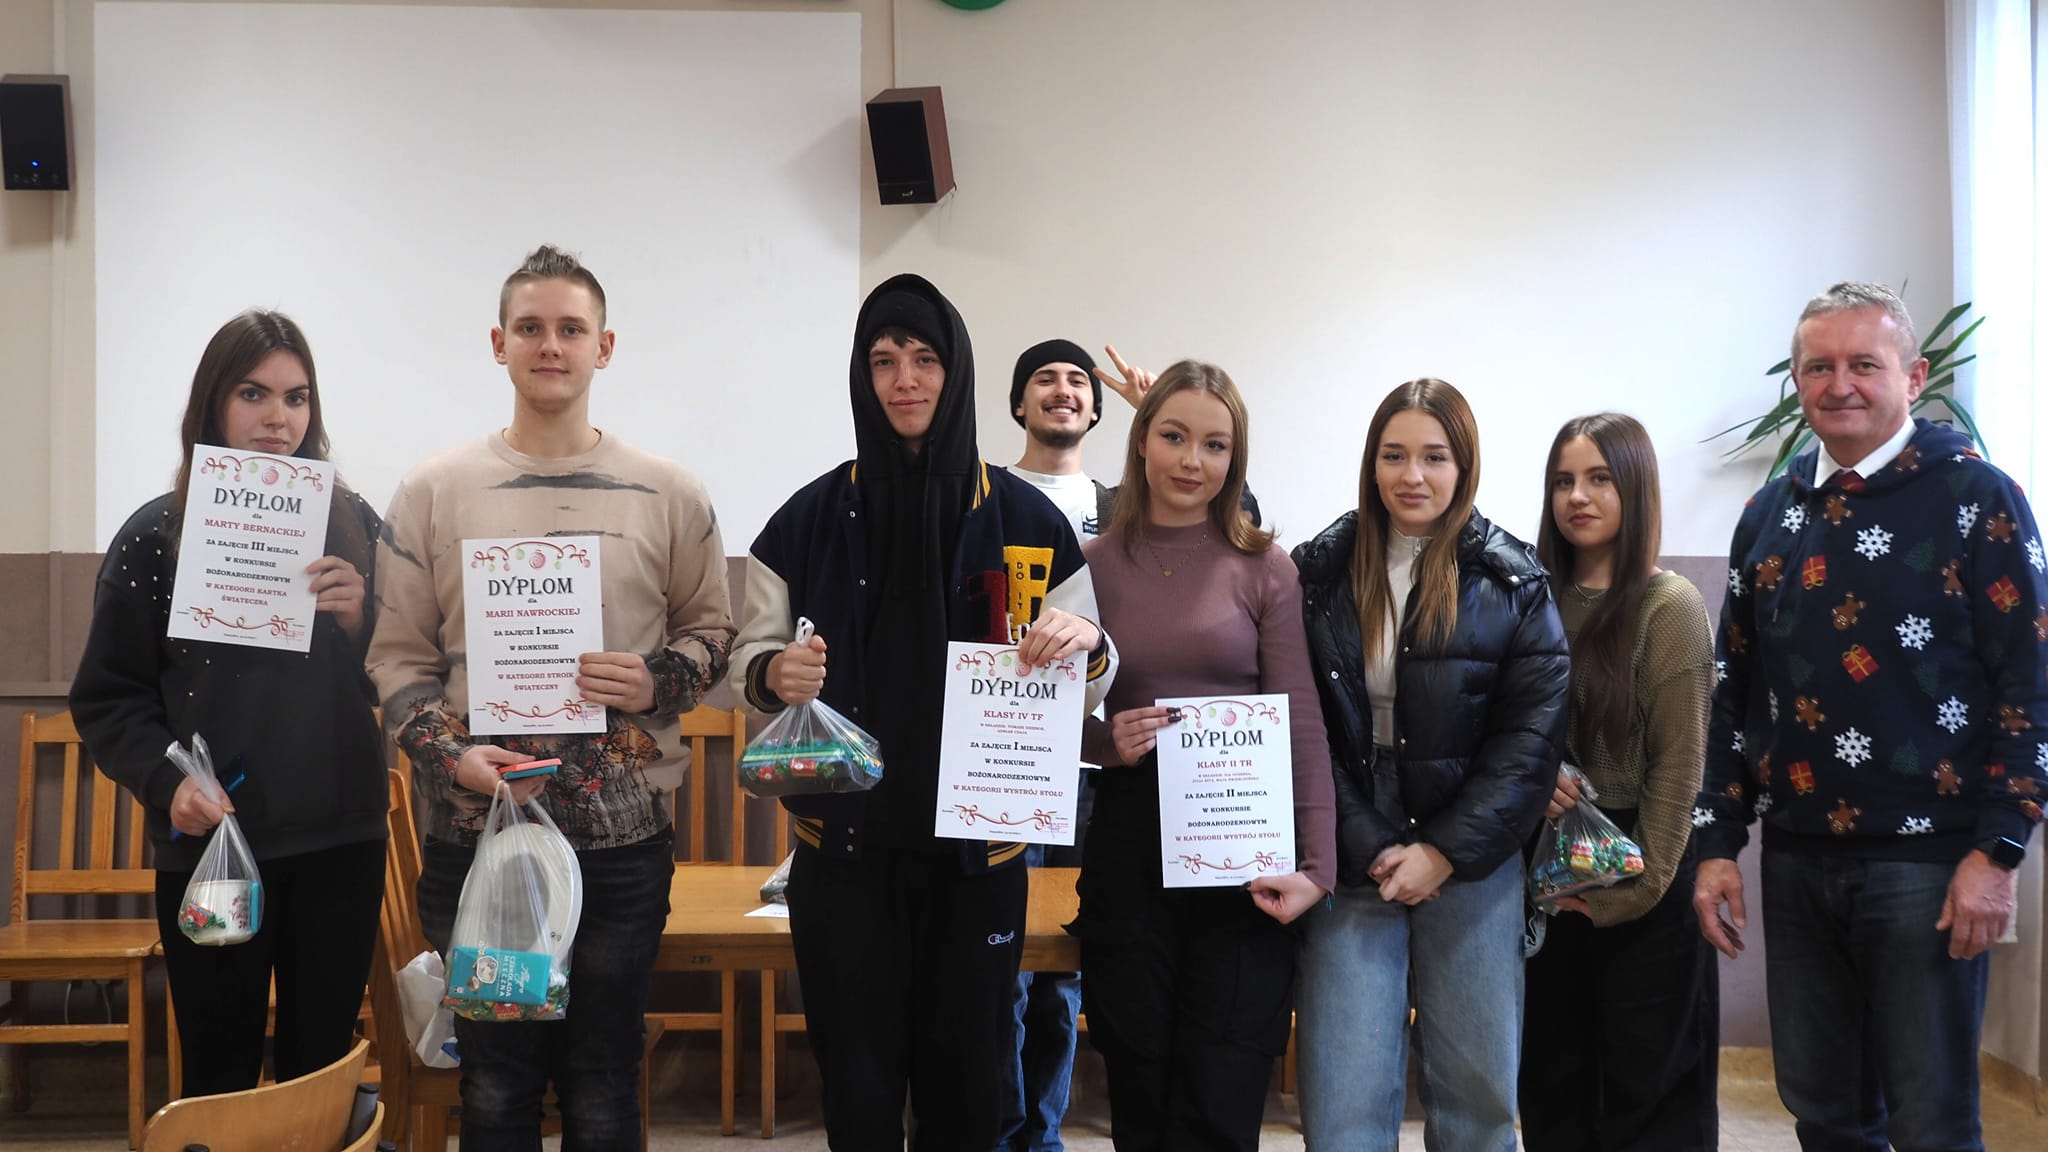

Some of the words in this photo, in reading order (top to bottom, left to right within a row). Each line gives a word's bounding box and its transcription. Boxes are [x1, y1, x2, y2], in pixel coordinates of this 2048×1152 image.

[214, 487, 302, 514] DYPLOM
[204, 518, 240, 530] MARTY
[243, 524, 305, 537] BERNACKIEJ
[218, 540, 249, 550] ZAJĘCIE
[251, 541, 265, 552] III
[267, 546, 299, 555] MIEJSCA
[234, 557, 277, 568] KONKURSIE
[206, 568, 291, 584] BOŻONARODZENIOWYM
[1016, 562, 1024, 580] DO
[214, 583, 255, 594] KATEGORII
[257, 588, 288, 597] KARTKA
[488, 576, 573, 596] DYPLOM
[221, 594, 268, 606] ŚWIĄTECZNA
[517, 608, 580, 617] NAWROCKIEJ
[536, 626, 541, 635] I
[494, 657, 576, 666] BOŻONARODZENIOWYM
[971, 677, 1057, 700] DYPLOM
[984, 710, 1015, 719] KLASY
[1018, 712, 1029, 720] IV
[1031, 713, 1044, 721] TF
[1181, 729, 1263, 748] DYPLOM
[1014, 742, 1018, 750] I
[993, 758, 1036, 766] KONKURSIE
[1197, 760, 1227, 769] KLASY
[968, 771, 1050, 782] BOŻONARODZENIOWYM
[961, 785, 1001, 793] KATEGORII
[1004, 787, 1038, 796] WYSTRÓJ
[1226, 789, 1234, 797] II
[1188, 819, 1267, 828] BOŻONARODZENIOWYM
[1224, 832, 1256, 840] WYSTRÓJ
[499, 956, 510, 996] MLECZNA
[506, 956, 516, 997] CZEKOLADA
